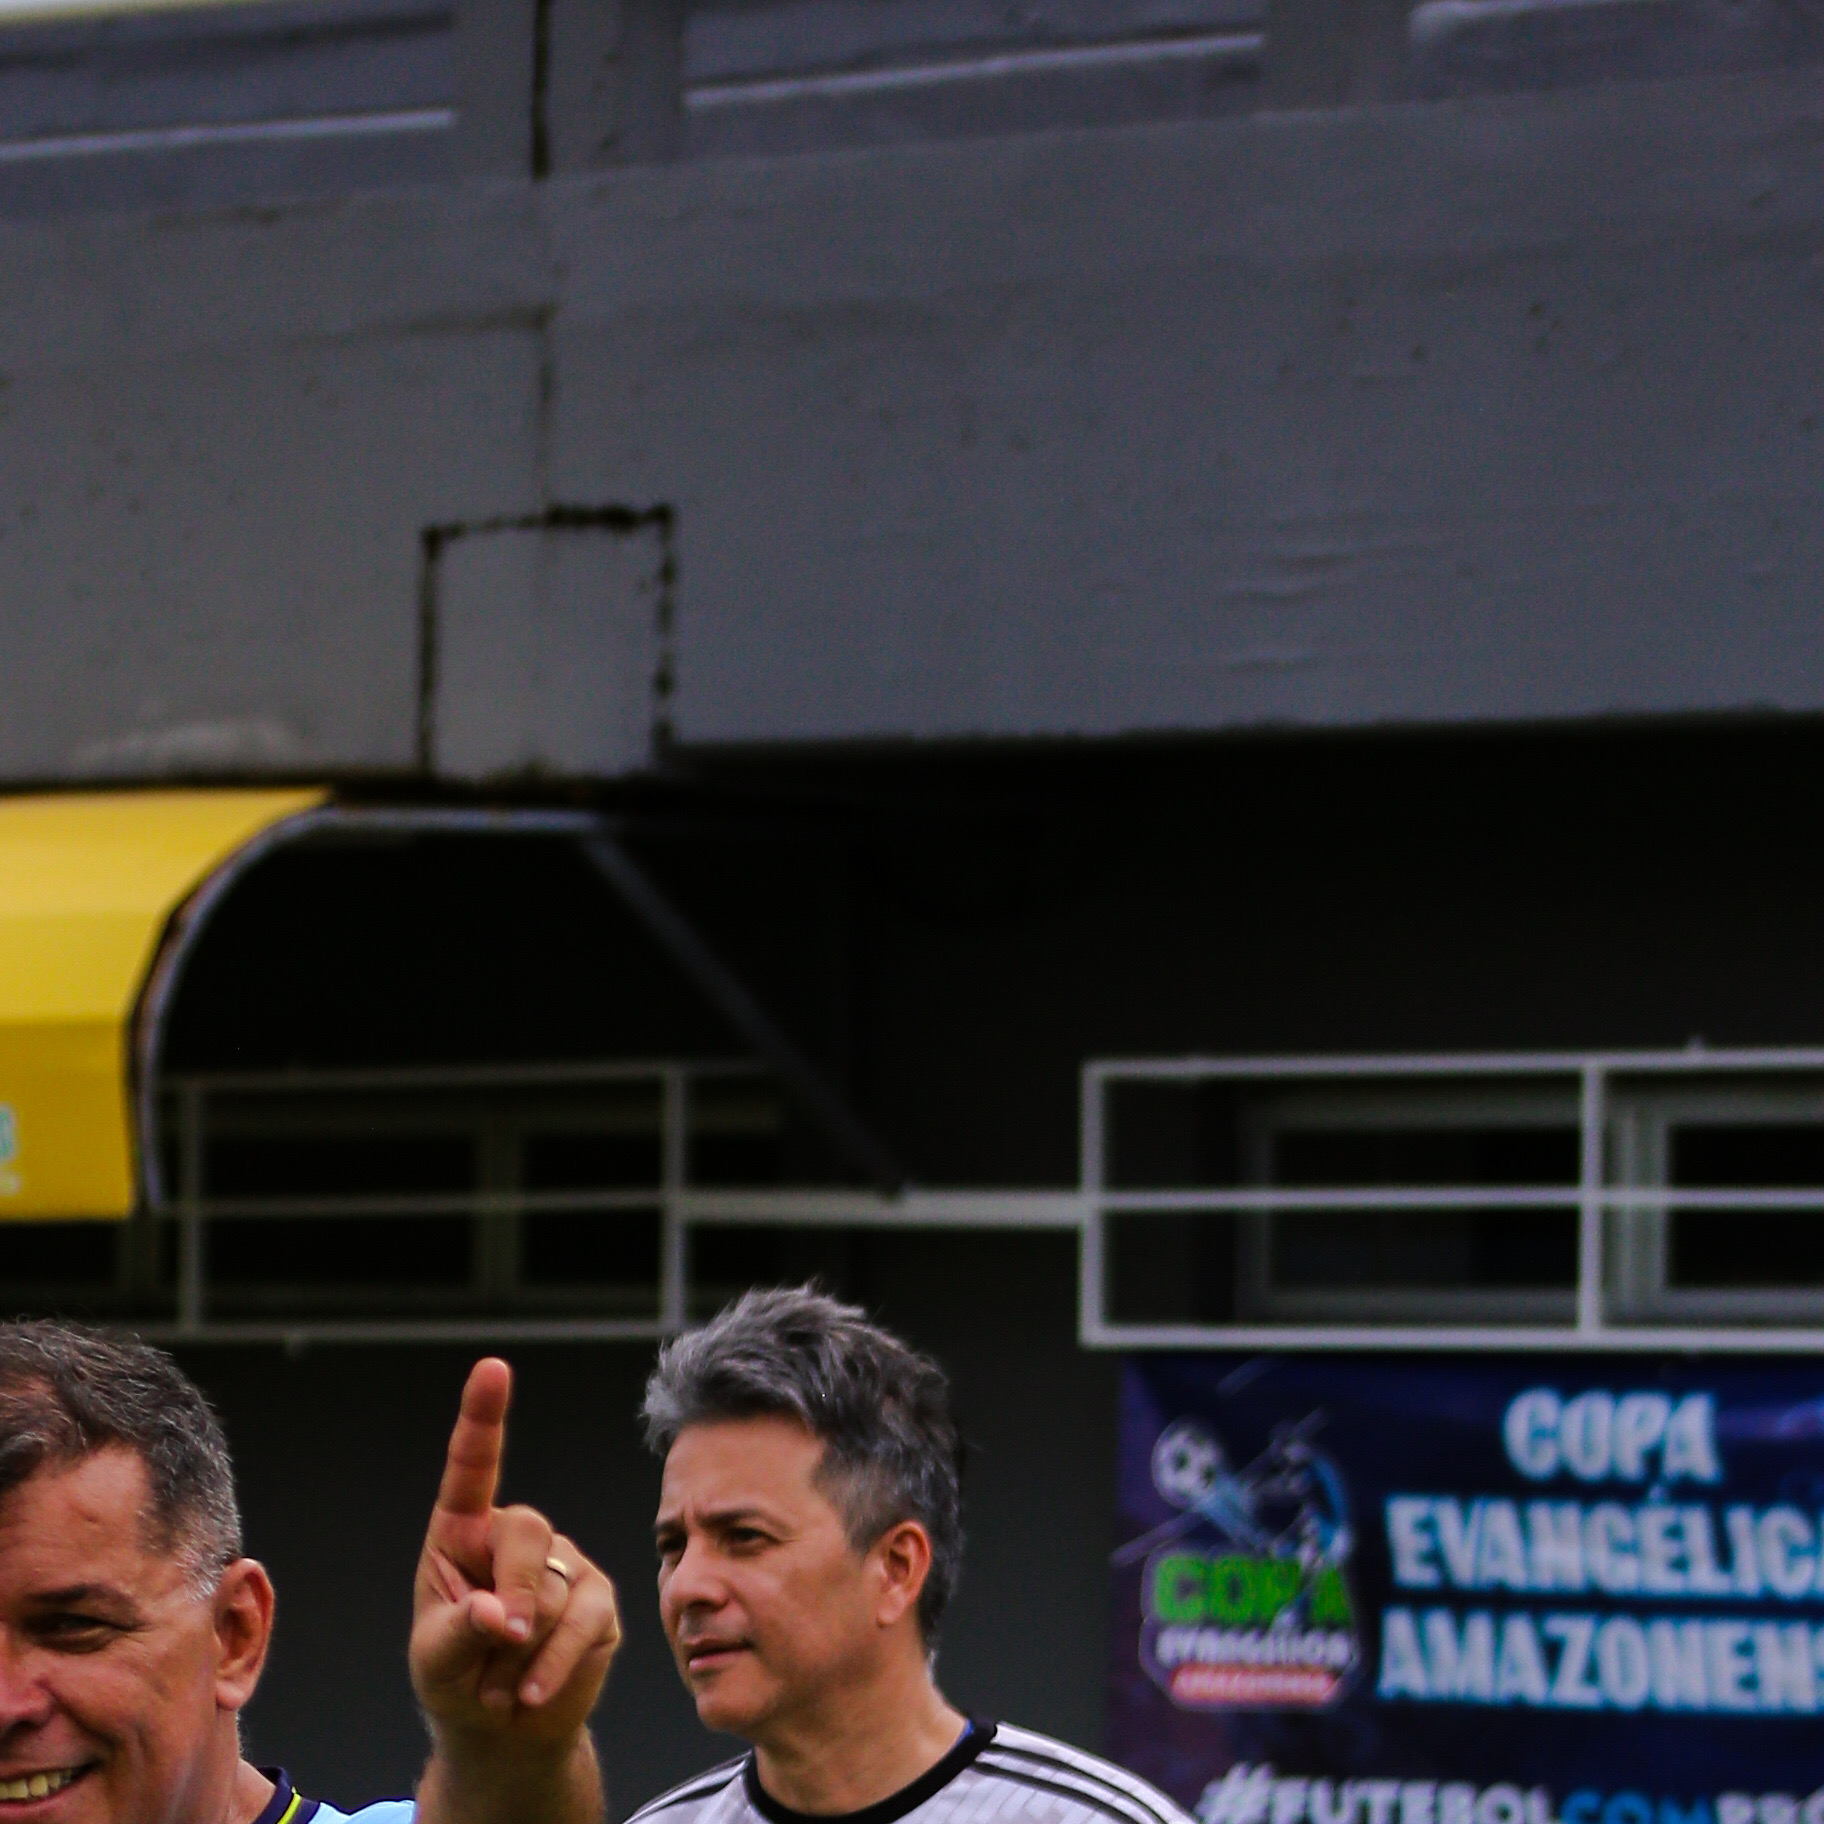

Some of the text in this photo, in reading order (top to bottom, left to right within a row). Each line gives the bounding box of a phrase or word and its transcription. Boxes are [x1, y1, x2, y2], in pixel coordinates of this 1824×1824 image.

[1504, 1388, 1724, 1483] COPA
[1152, 1552, 1354, 1625] COPA
[1384, 1487, 1824, 1598] EVANGÉLIC
